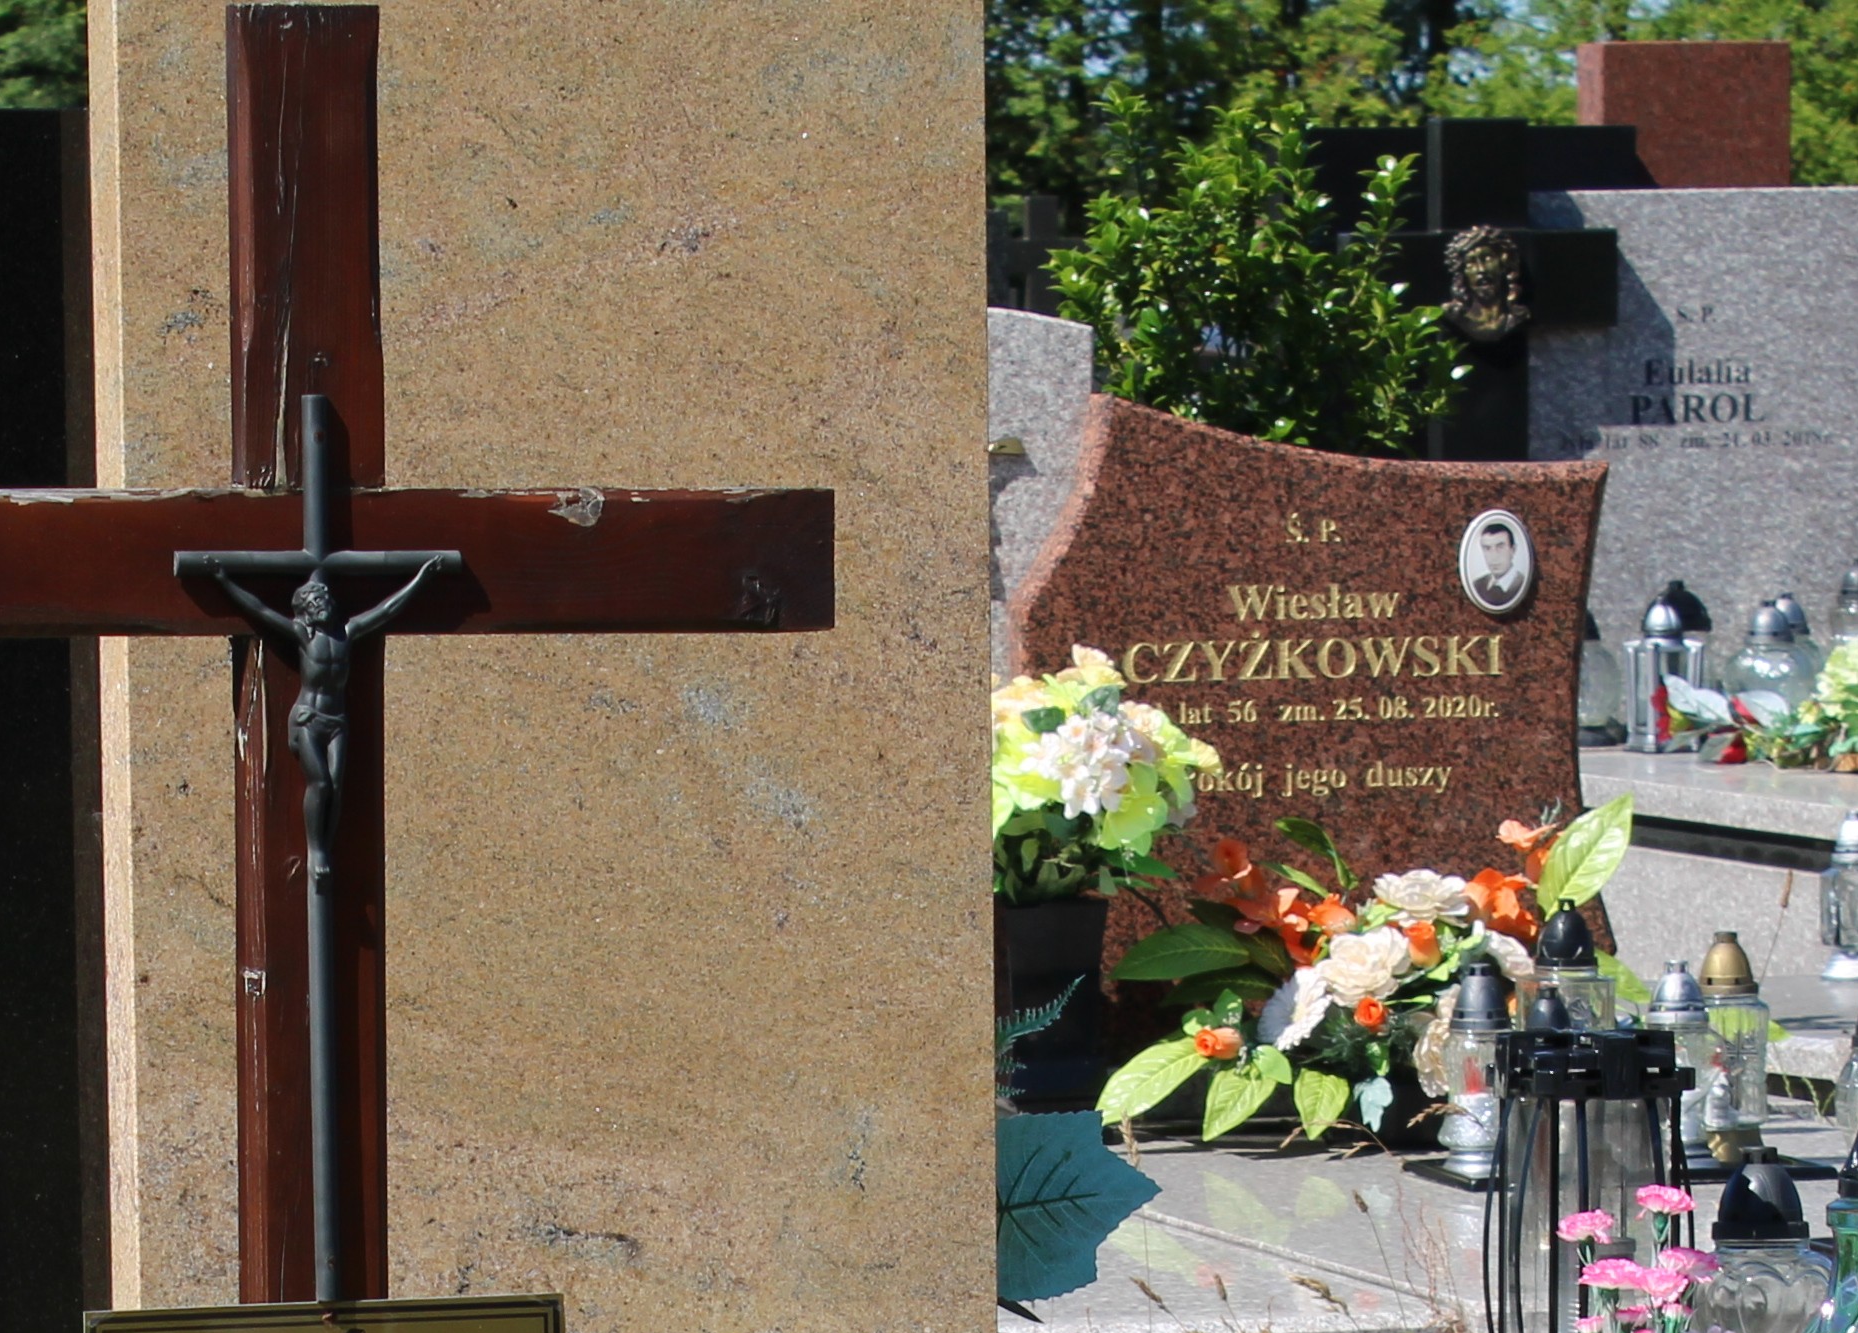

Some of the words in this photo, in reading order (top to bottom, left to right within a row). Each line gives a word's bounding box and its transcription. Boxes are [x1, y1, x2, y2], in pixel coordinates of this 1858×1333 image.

[1645, 358, 1751, 385] Eulalia
[1629, 393, 1765, 425] PAROL
[1285, 512, 1310, 544] Ś.
[1319, 519, 1343, 544] P.
[1228, 583, 1401, 623] Wiesław
[1121, 629, 1505, 686] CZYŻKOWSKI
[1179, 701, 1213, 725] lat
[1227, 699, 1258, 723] 56
[1278, 704, 1326, 722] zm.
[1332, 697, 1371, 721] 25.
[1378, 695, 1416, 720] 08.
[1422, 694, 1500, 719] 2020r.
[1188, 762, 1265, 797] okój
[1281, 763, 1348, 798] jego
[1365, 760, 1453, 794] duszy
